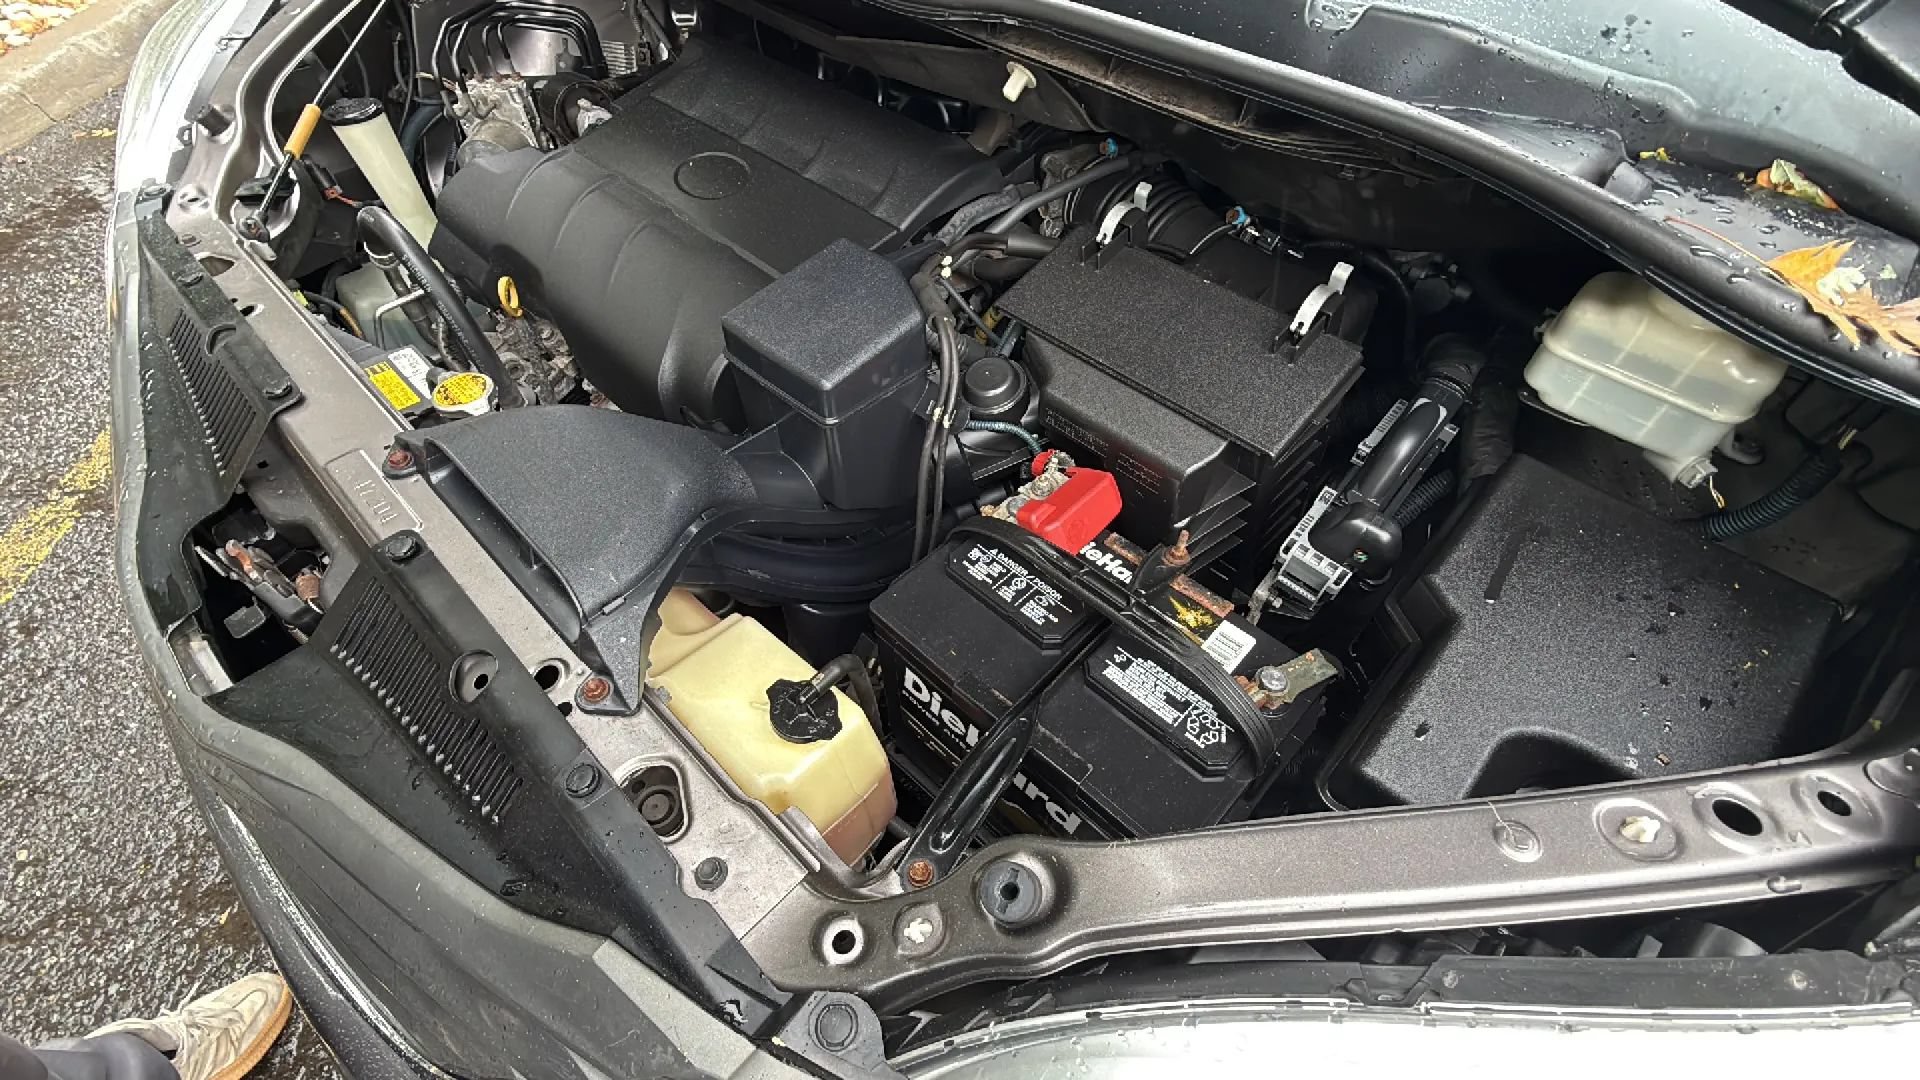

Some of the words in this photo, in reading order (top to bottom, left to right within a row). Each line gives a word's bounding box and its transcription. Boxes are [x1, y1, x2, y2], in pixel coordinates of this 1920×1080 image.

[997, 552, 1029, 577] DANGER
[1033, 577, 1063, 601] POISON
[1079, 541, 1134, 585] ieHa
